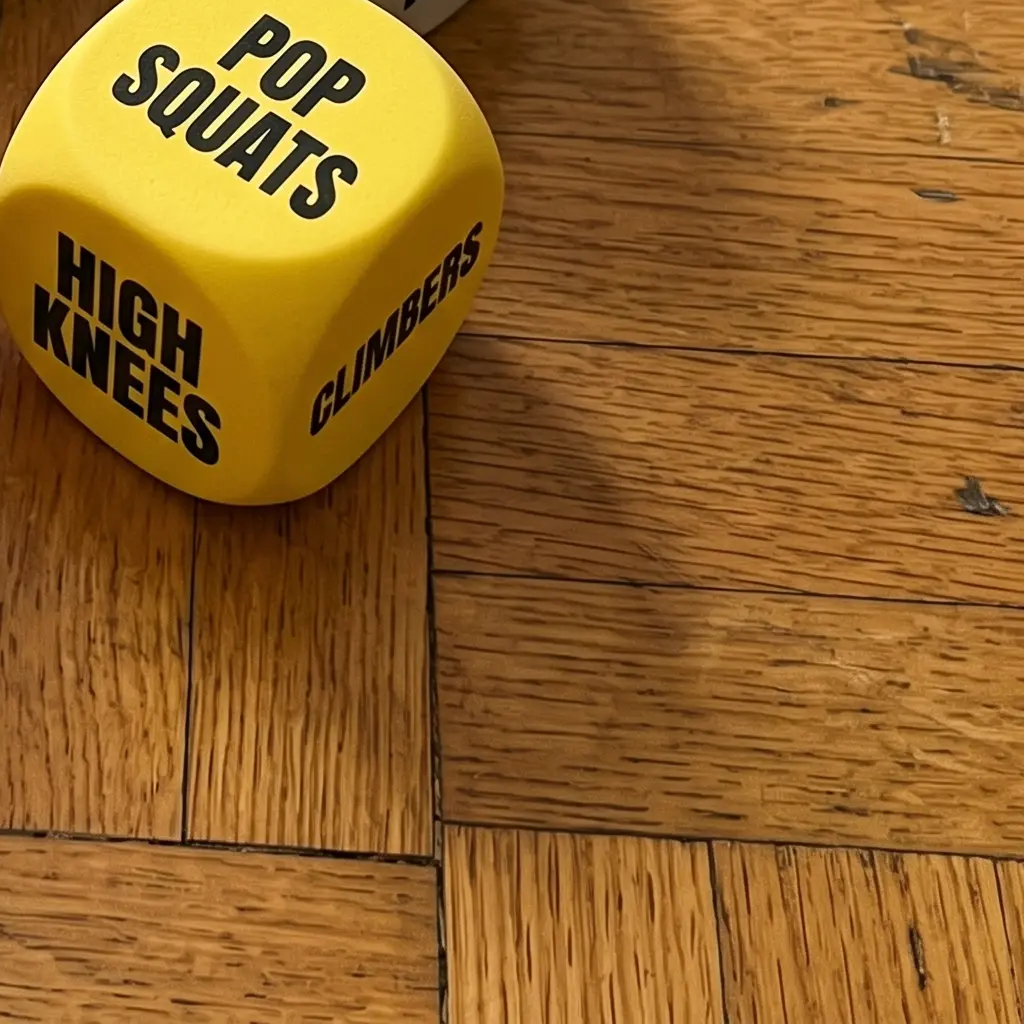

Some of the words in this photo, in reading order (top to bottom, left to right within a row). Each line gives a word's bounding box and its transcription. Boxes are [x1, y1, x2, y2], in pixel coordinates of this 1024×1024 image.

[112, 45, 358, 219] SQUATS
[217, 14, 366, 118] POP
[33, 283, 221, 466] KNEES
[57, 231, 203, 389] HIGH
[310, 222, 484, 436] CLIMBERS
